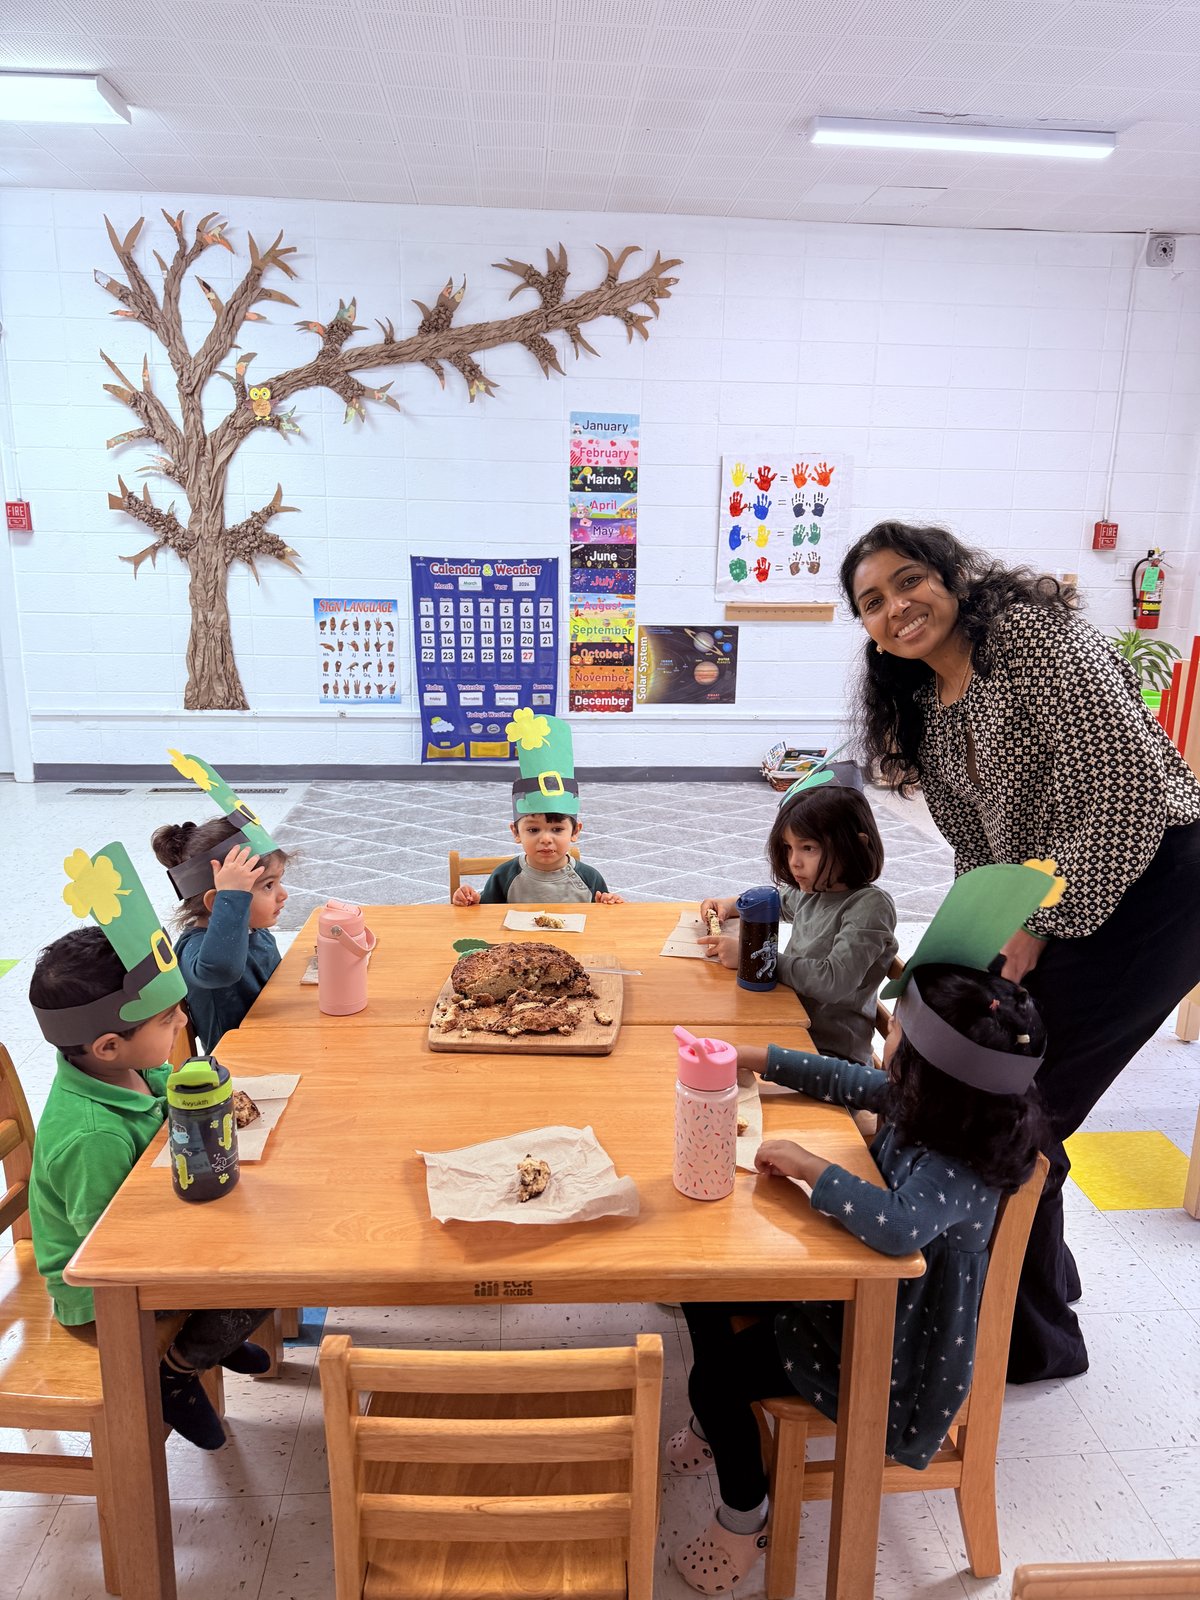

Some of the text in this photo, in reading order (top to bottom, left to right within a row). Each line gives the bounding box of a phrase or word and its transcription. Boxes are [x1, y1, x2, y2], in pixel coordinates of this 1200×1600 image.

[582, 420, 628, 434] January
[580, 447, 629, 460] February
[587, 474, 621, 484] March
[7, 506, 24, 516] FIRE
[591, 500, 616, 512] April
[593, 526, 614, 537] May
[1102, 527, 1117, 537] FIRE
[589, 551, 617, 561] June
[430, 562, 541, 576] Calendar & Weather
[591, 576, 615, 588] July
[319, 600, 393, 613] SIGN LANGUAGE
[584, 601, 622, 612] August
[573, 625, 632, 636] September
[463, 652, 473, 660] 24
[580, 649, 624, 658] October
[638, 637, 649, 700] Solar System
[575, 673, 629, 682] November
[575, 696, 629, 705] December
